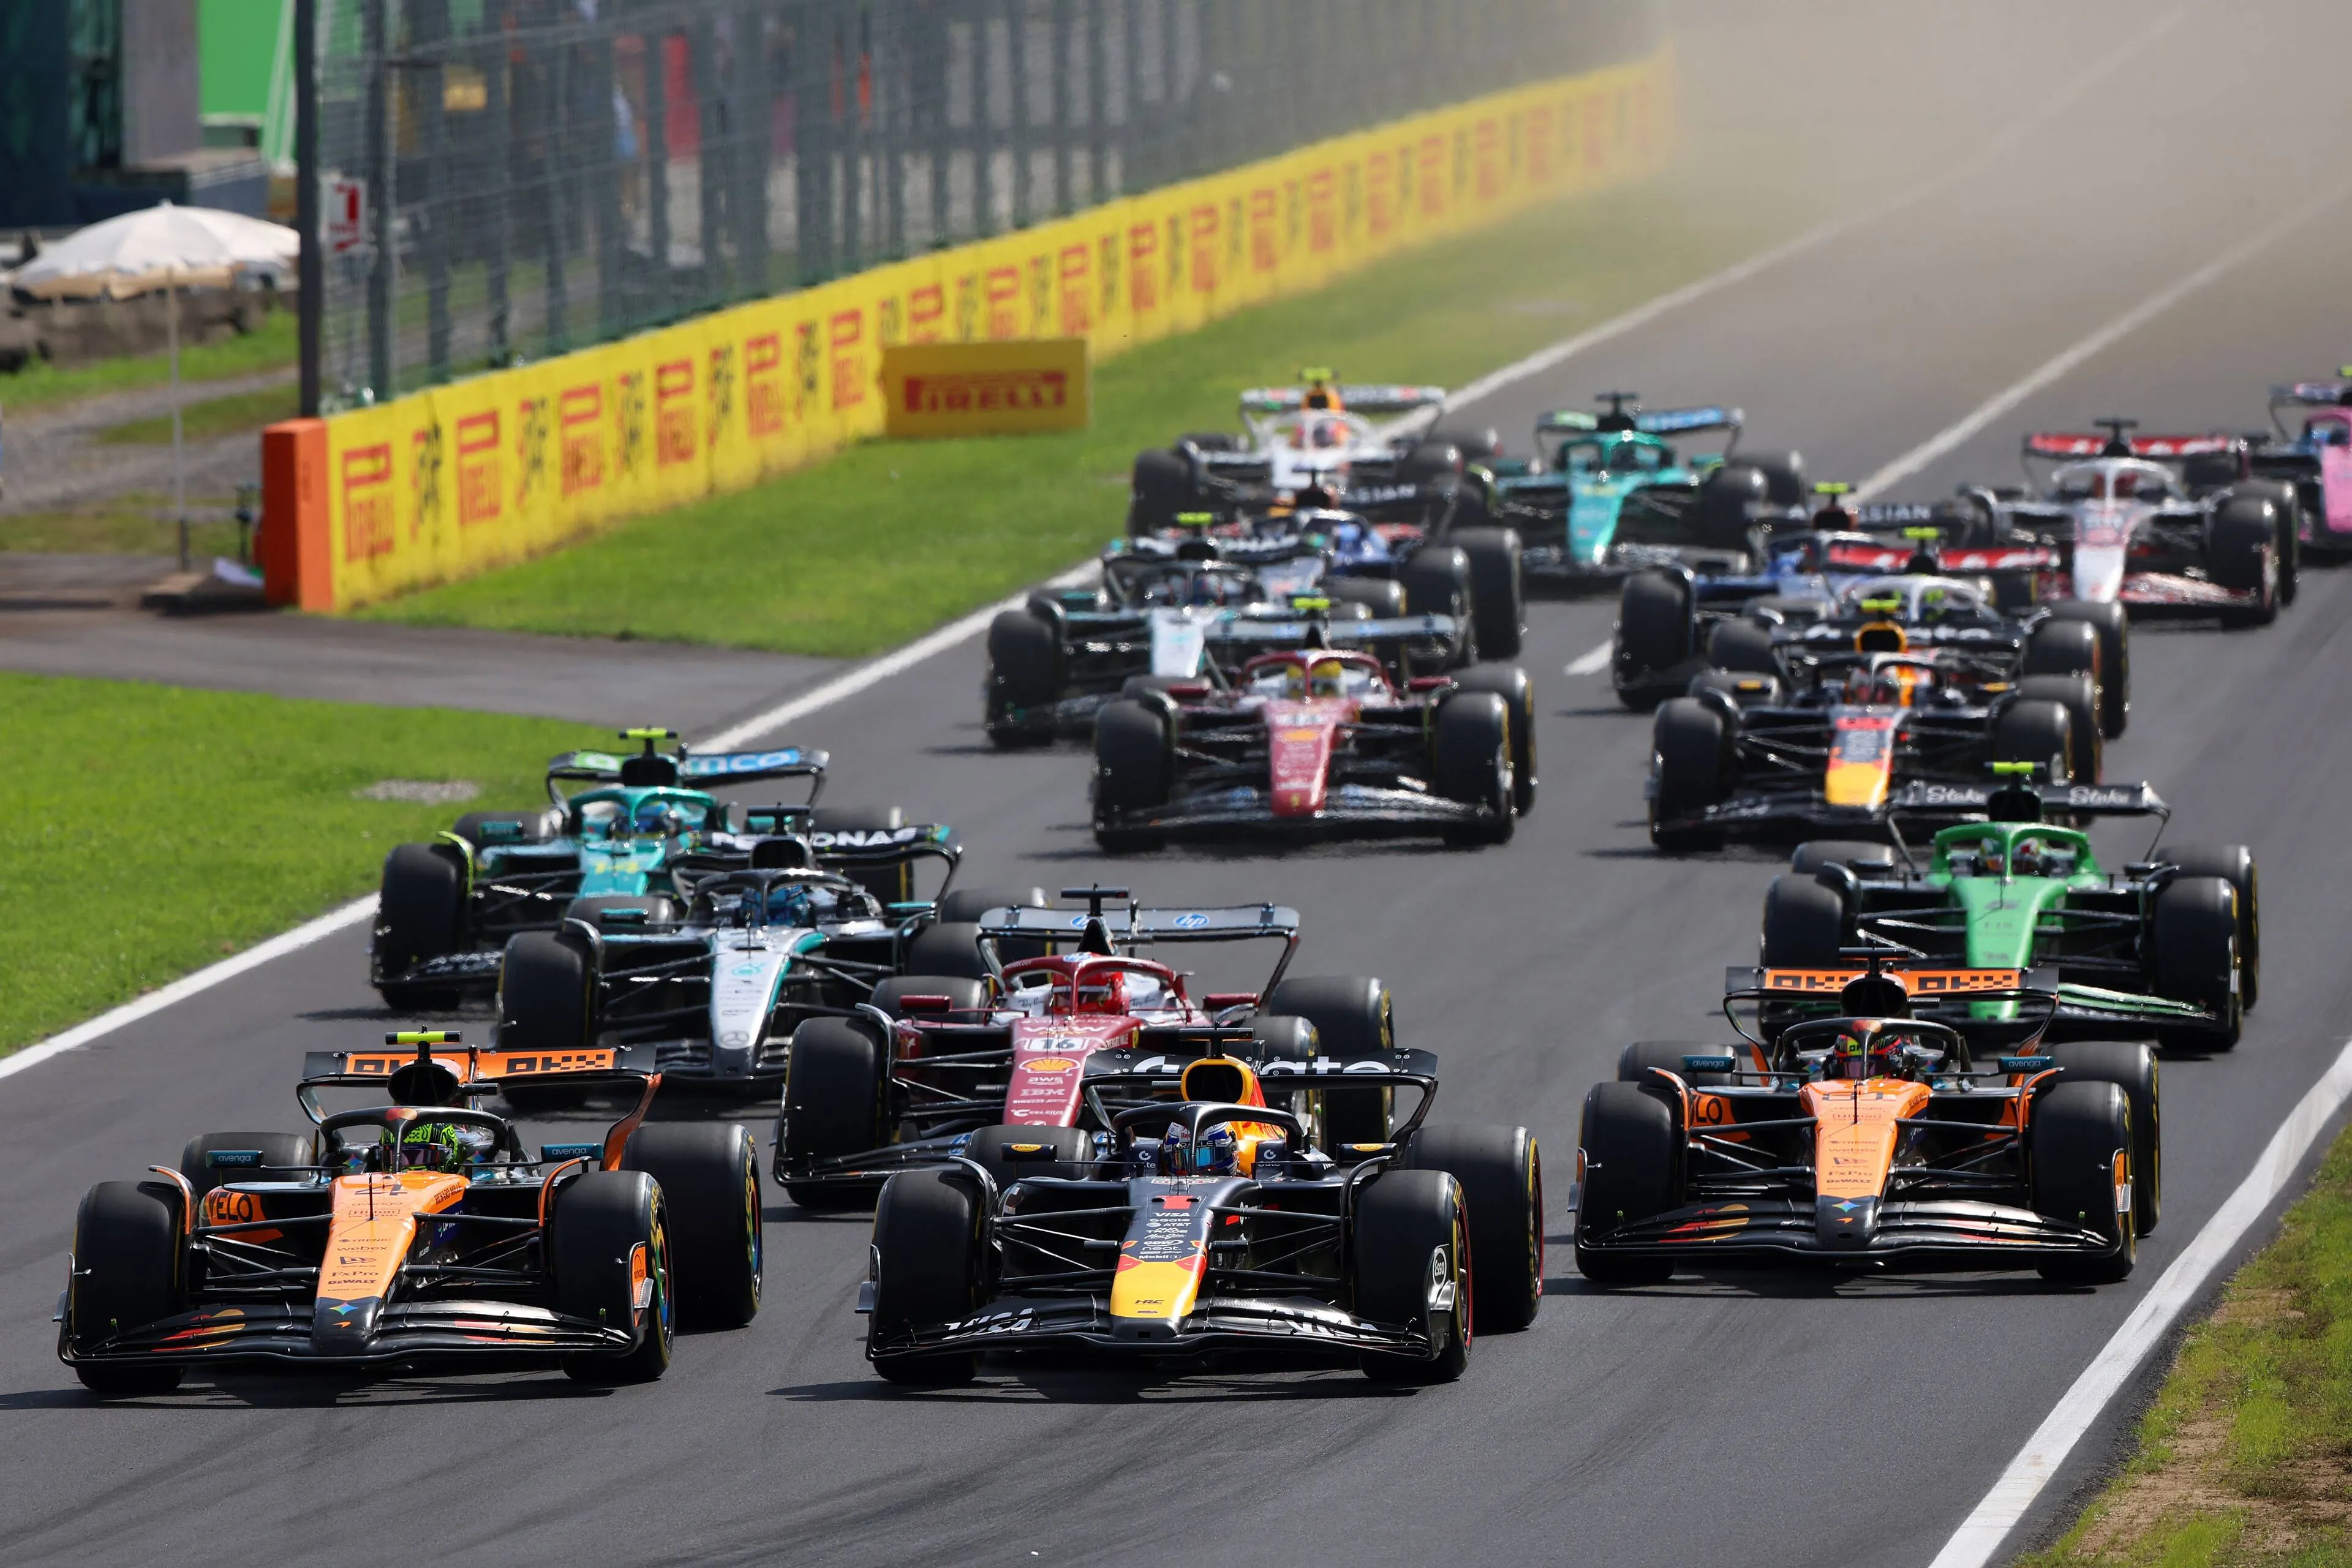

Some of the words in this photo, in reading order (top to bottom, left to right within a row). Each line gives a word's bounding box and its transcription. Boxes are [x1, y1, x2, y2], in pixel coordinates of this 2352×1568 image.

[583, 750, 792, 773] amco
[2068, 786, 2131, 806] Stake
[505, 1053, 606, 1075] OKX
[1692, 1059, 1725, 1069] avenga
[2009, 1060, 2041, 1069] avenga
[552, 1147, 587, 1156] avenga
[218, 1155, 252, 1164] avenga
[1434, 1259, 1446, 1277] Esso
